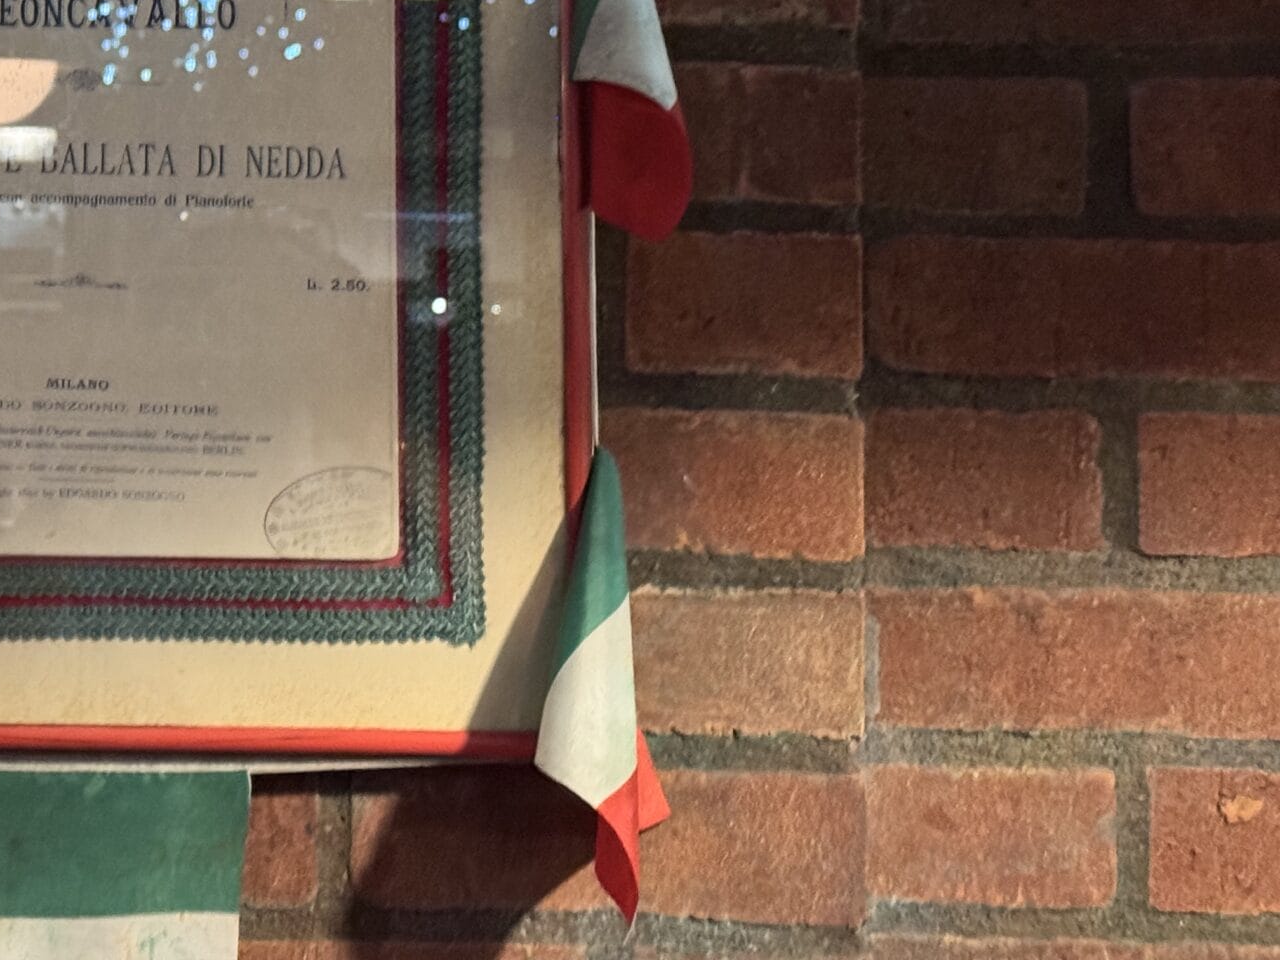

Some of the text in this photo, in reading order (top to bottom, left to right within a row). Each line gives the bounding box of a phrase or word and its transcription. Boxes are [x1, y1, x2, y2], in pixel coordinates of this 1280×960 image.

[196, 143, 226, 178] DI
[245, 144, 348, 180] NEDDA
[30, 191, 157, 208] accompagnamento
[164, 193, 177, 207] di
[185, 194, 255, 209] Pianoforte
[46, 376, 111, 391] MILANO
